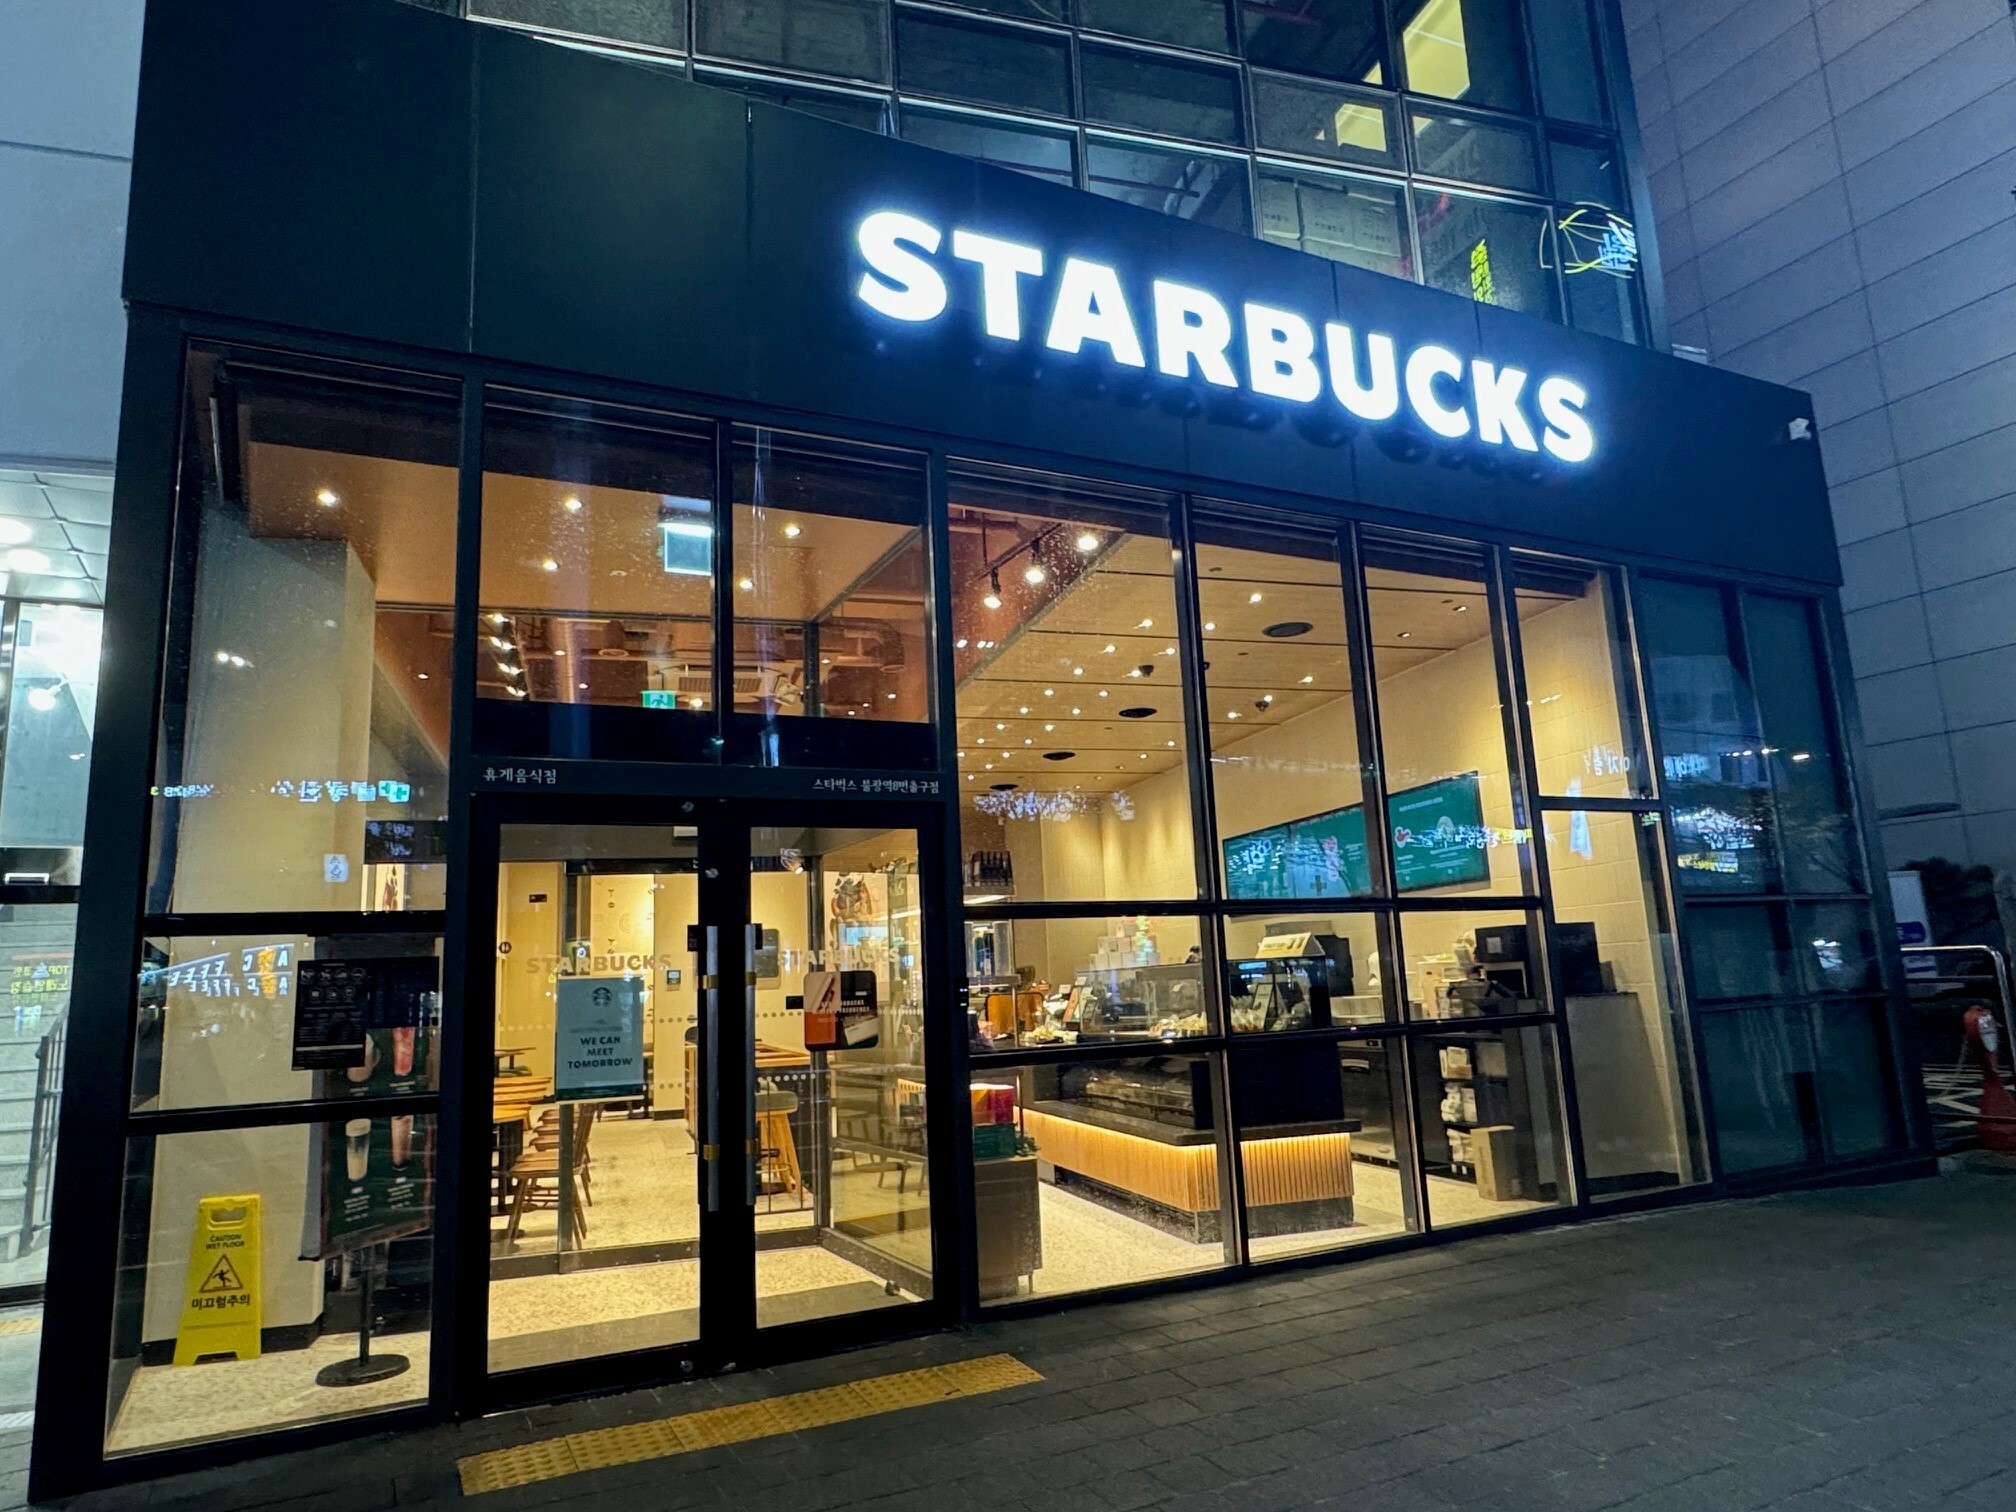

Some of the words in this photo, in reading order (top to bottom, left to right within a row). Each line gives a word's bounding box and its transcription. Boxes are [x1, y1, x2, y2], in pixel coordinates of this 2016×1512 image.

[857, 211, 1595, 463] STARBUCKS
[483, 767, 557, 784] 휴게음식점
[812, 778, 857, 792] 스타벅스
[526, 953, 672, 974] STARBUCKS
[580, 1037, 598, 1045] WE
[599, 1036, 621, 1044] CAN
[587, 1047, 614, 1056] MEET
[210, 1234, 242, 1242] CAUTION
[191, 1293, 251, 1310] 미끄럼주의
